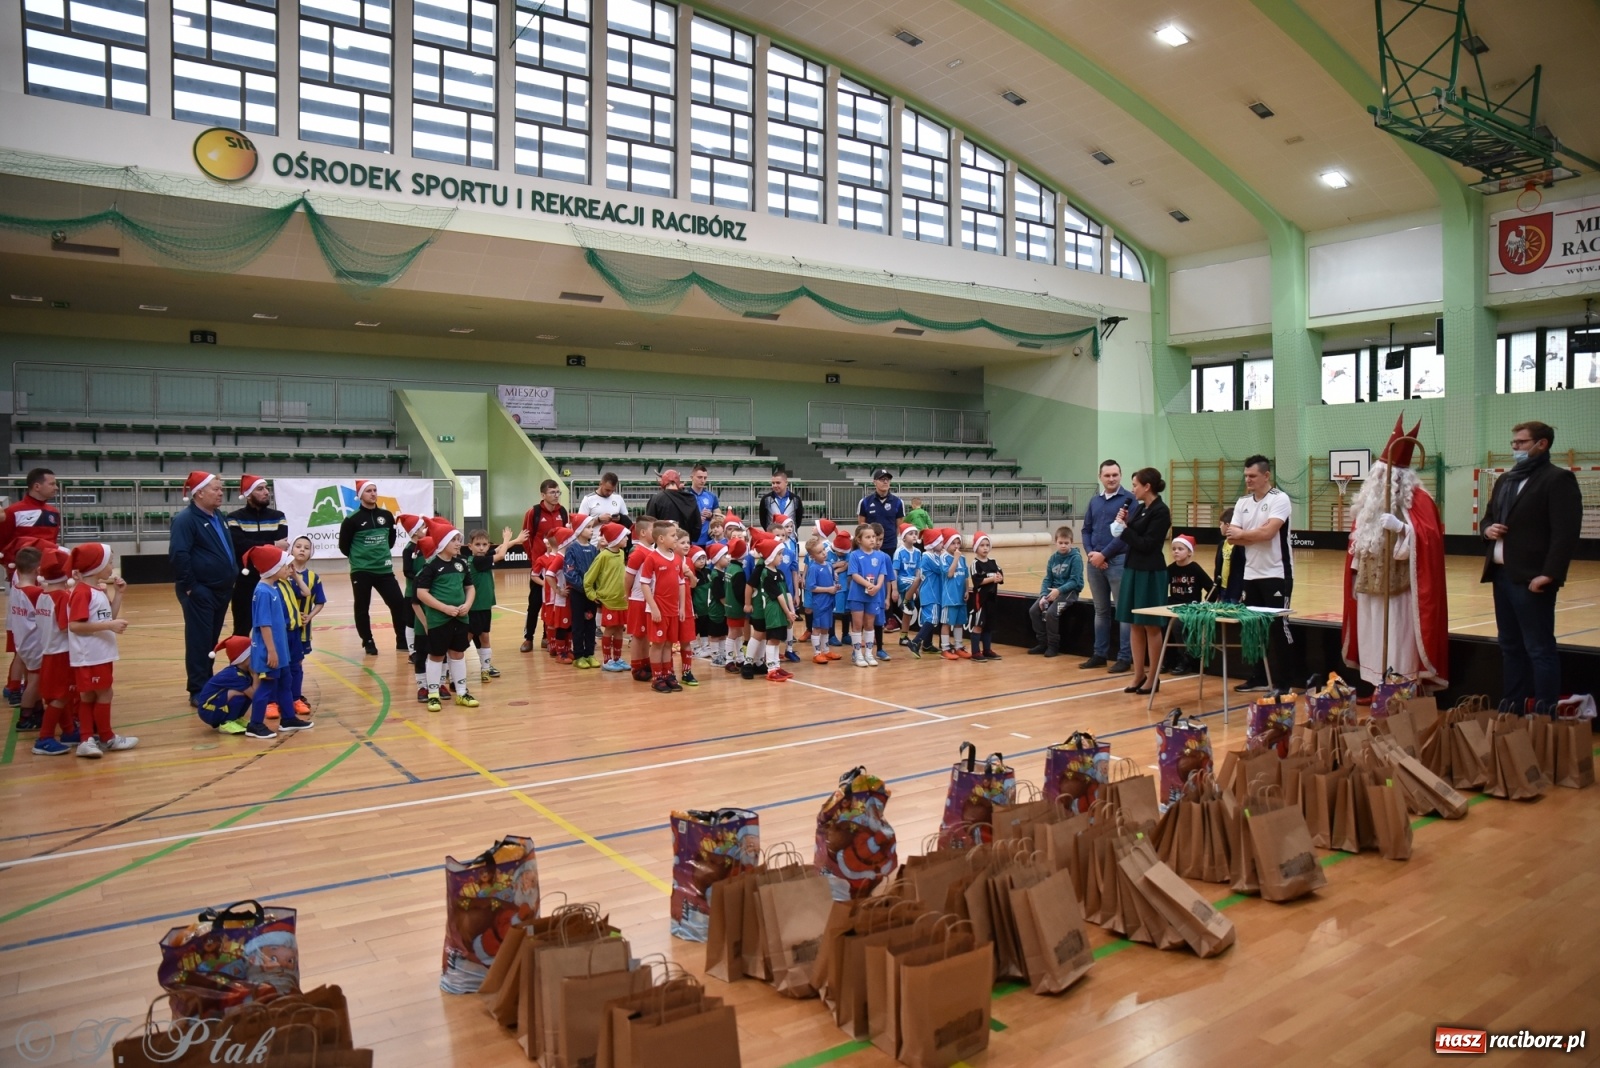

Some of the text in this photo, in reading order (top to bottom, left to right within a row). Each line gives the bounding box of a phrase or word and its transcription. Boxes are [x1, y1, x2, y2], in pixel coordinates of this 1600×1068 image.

[272, 150, 748, 242] OŚRODEK SPORTU I REKREACJI RACIBÓRZ
[505, 387, 549, 398] MIESZKO
[1051, 563, 1069, 575] 4F
